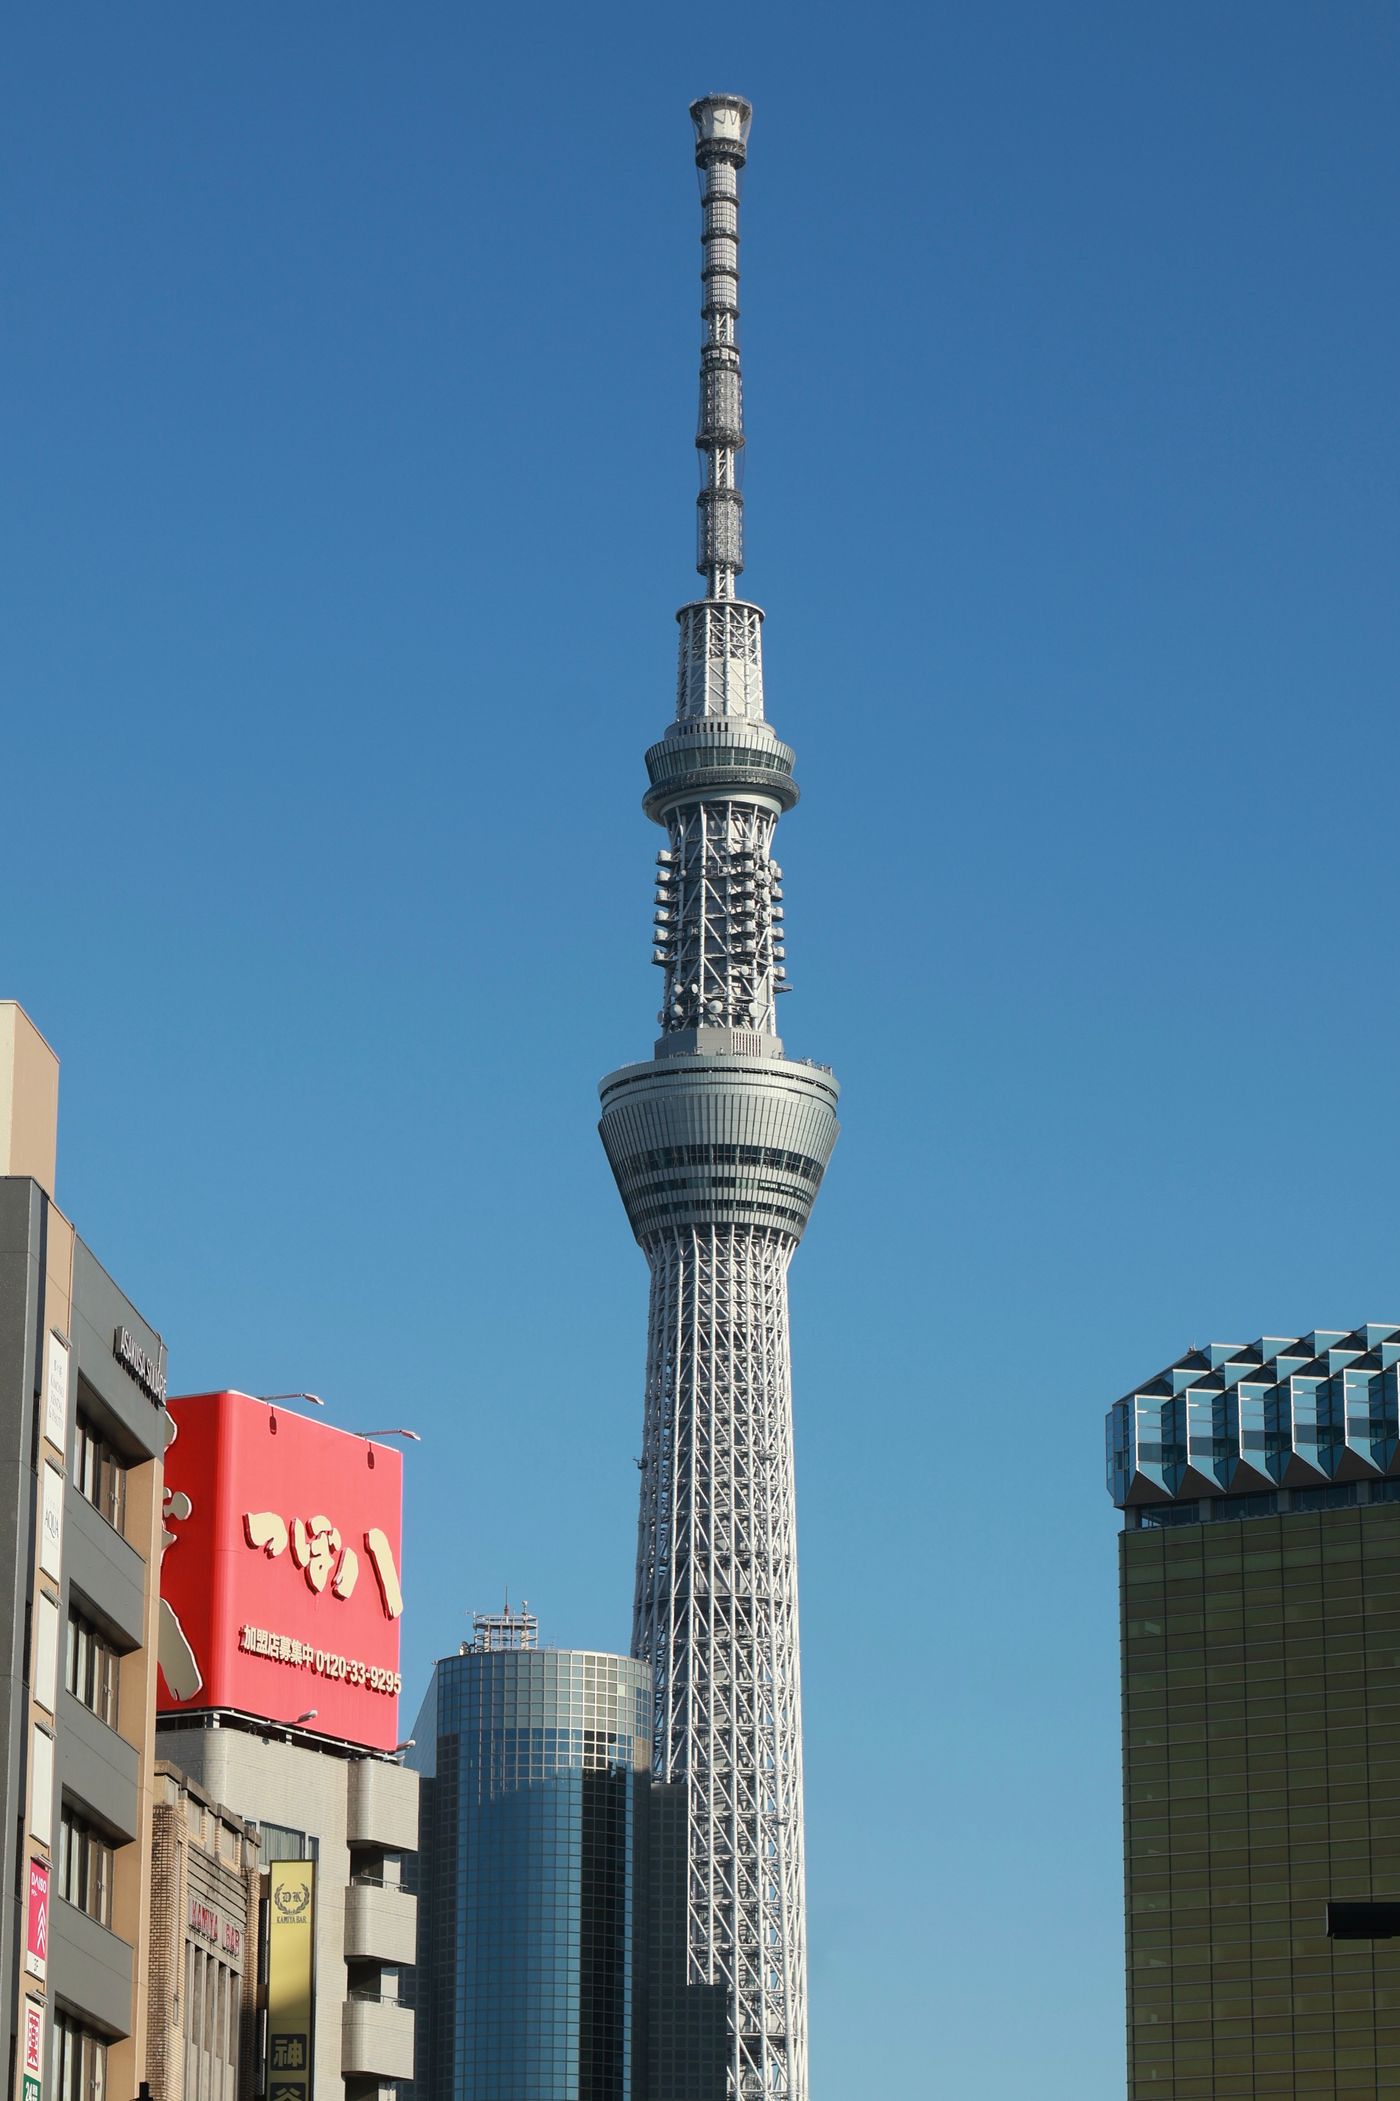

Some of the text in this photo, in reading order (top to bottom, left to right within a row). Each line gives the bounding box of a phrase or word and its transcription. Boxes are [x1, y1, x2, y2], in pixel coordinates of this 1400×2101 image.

[120, 1327, 146, 1380] ASAKUSA
[244, 1511, 404, 1621] つぼ八
[241, 1623, 402, 1695] 加盟店募集中 0120-33-9295
[31, 1871, 47, 1894] DAISO
[191, 1899, 240, 1956] KAMIYA BAR
[277, 1915, 307, 1924] KAMIYA BAR
